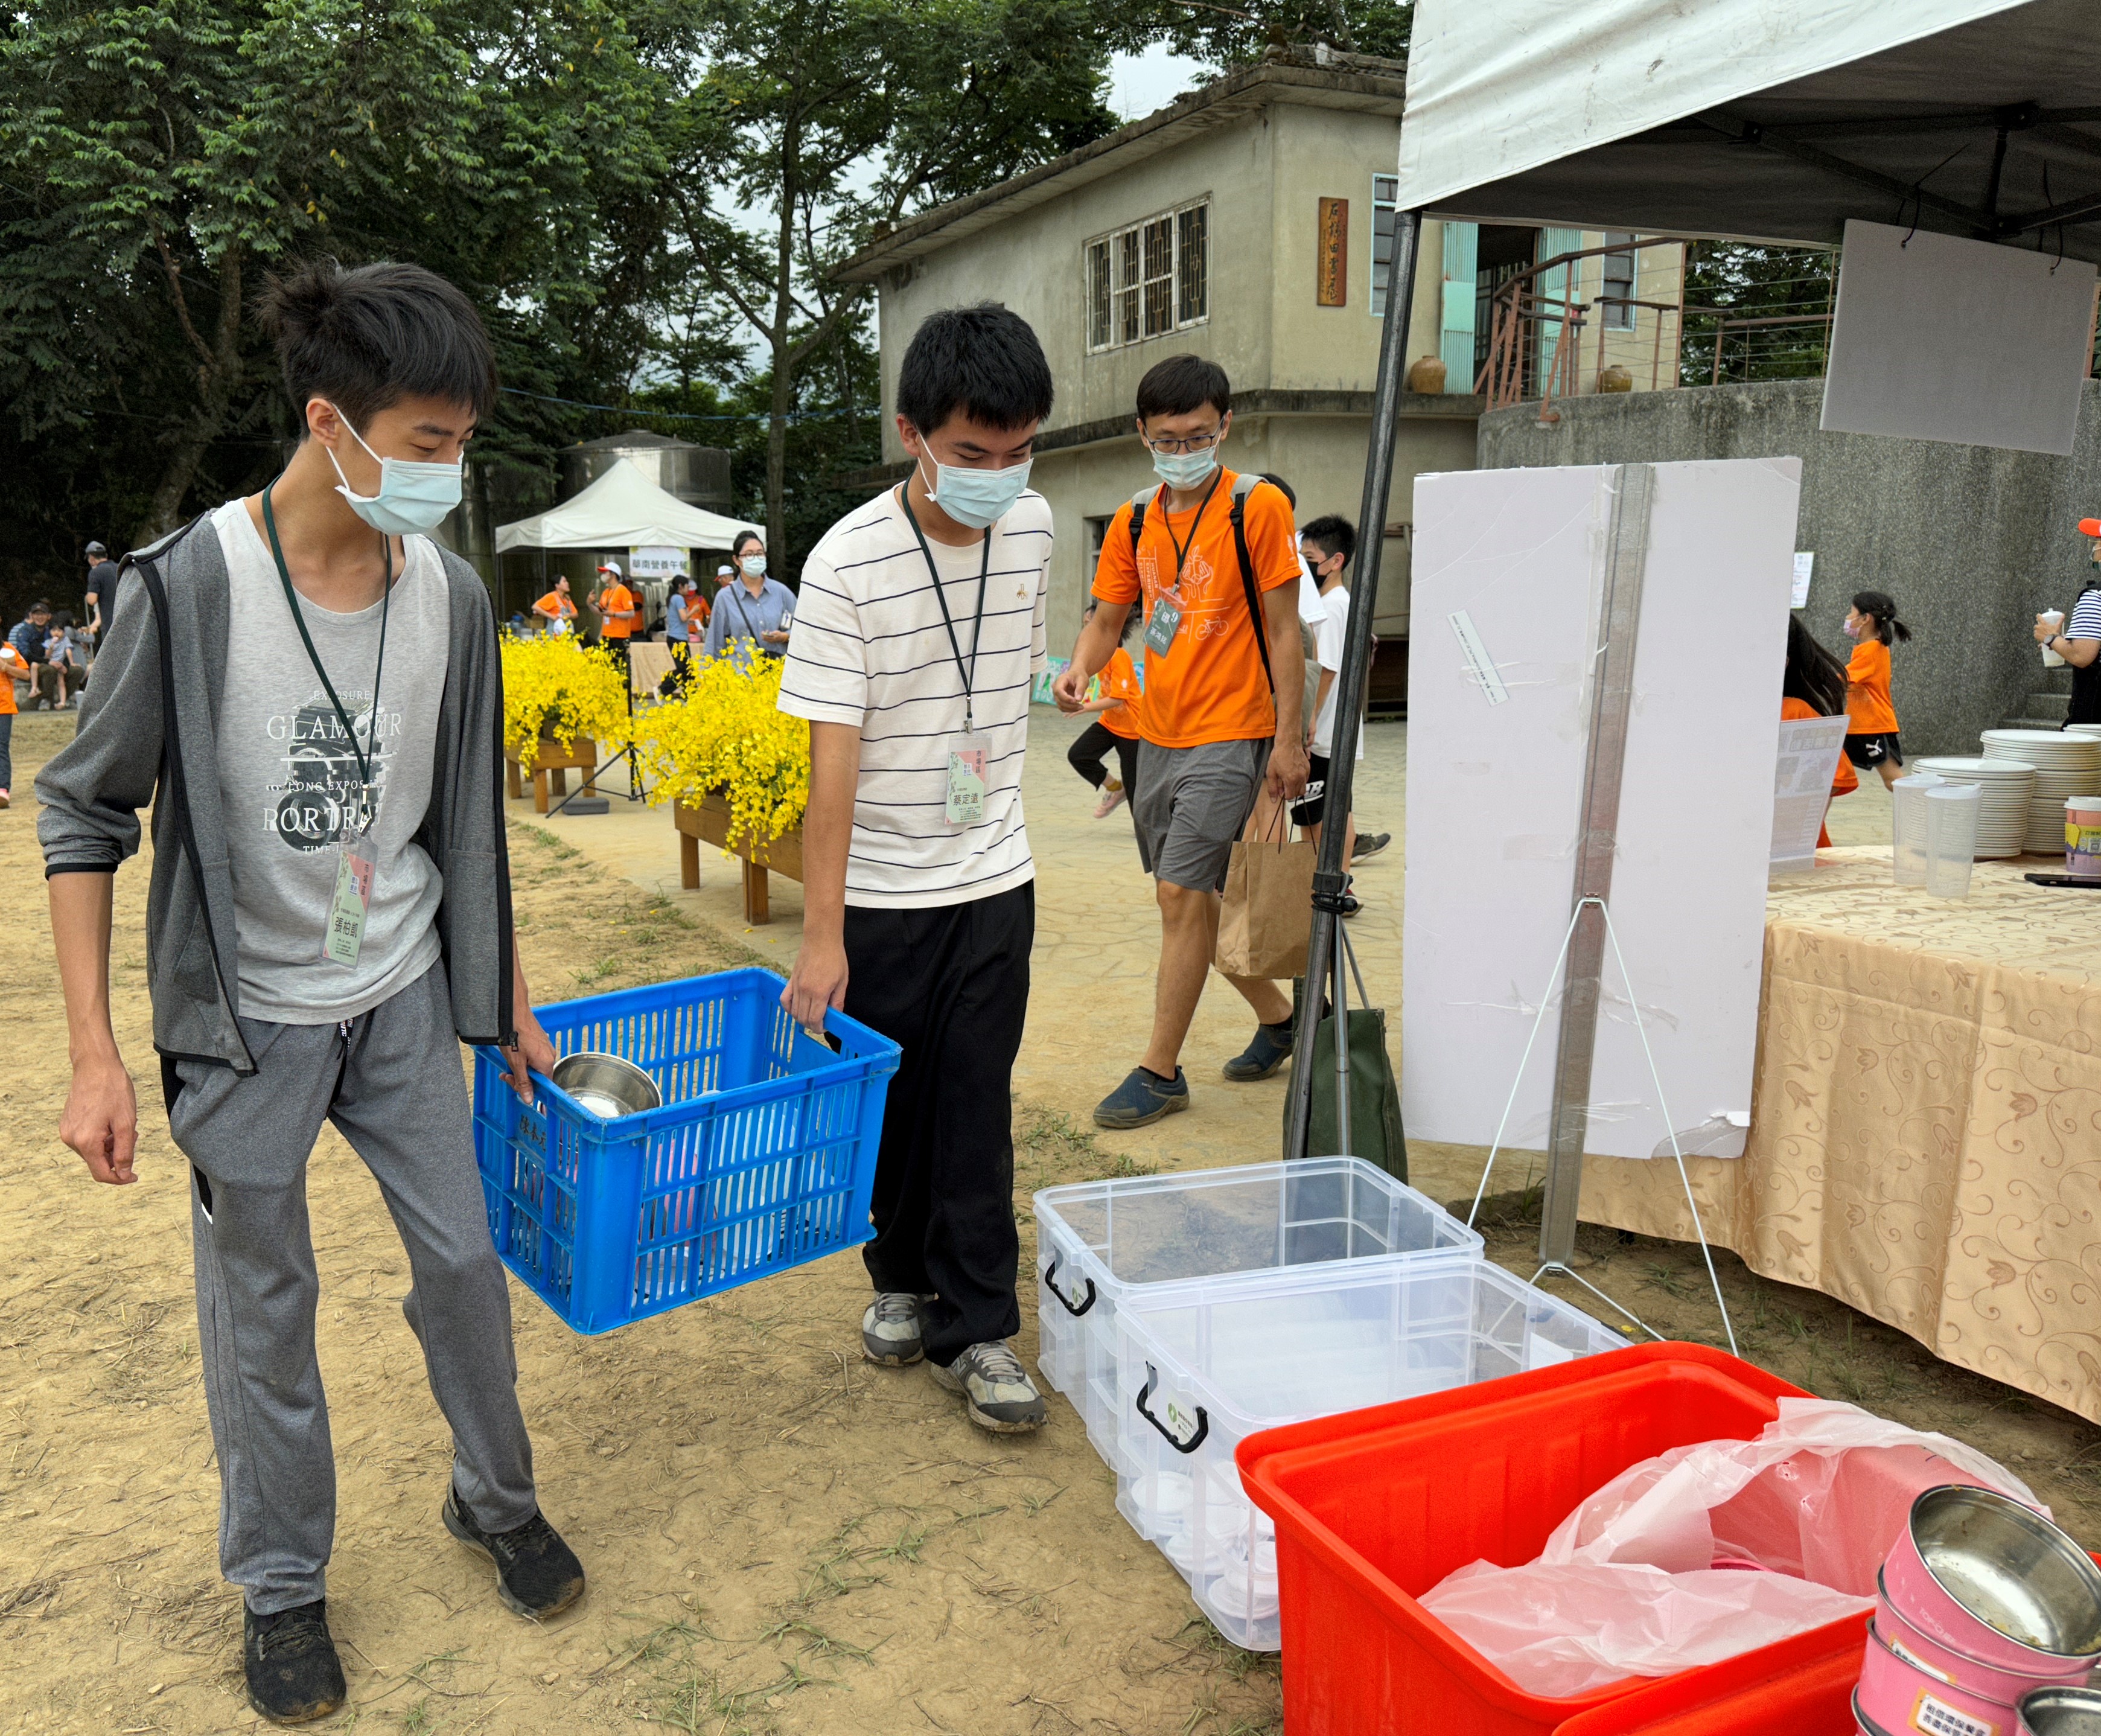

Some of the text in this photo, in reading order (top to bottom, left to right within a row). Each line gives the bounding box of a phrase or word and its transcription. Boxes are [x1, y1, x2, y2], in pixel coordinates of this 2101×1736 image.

[1171, 611, 1178, 623] 9
[313, 690, 370, 700] EXOSURE
[267, 713, 401, 740] GLAMOUR
